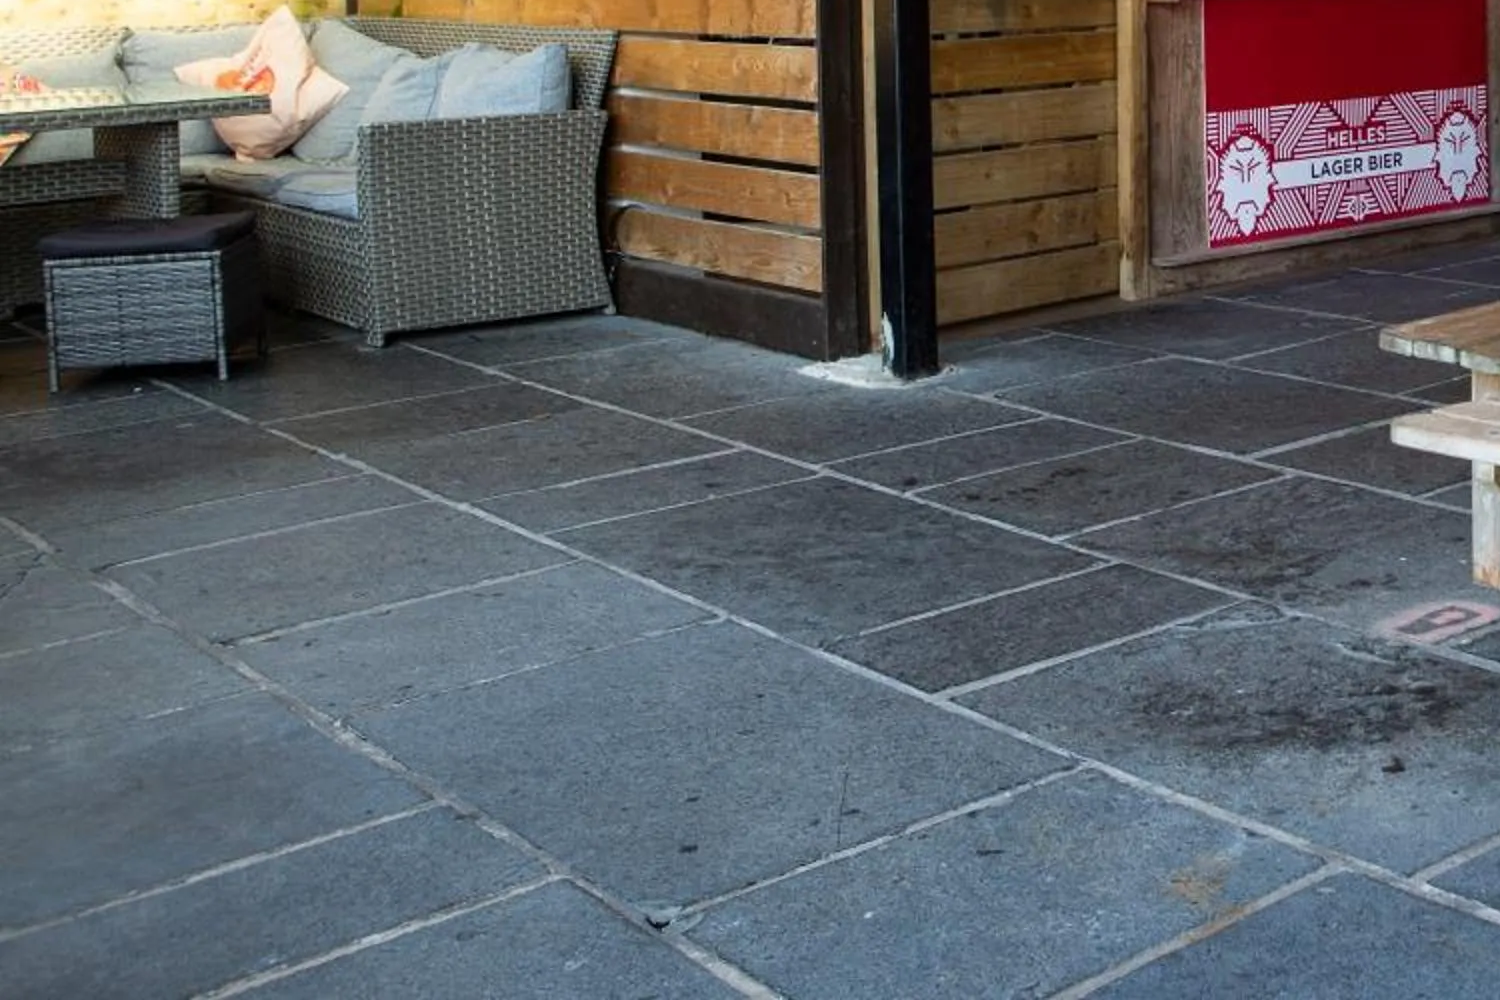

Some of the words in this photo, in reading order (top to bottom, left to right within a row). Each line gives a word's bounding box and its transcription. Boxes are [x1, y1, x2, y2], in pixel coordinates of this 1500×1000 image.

[1327, 126, 1386, 148] HELLES
[1311, 157, 1363, 179] LAGER
[1369, 152, 1403, 171] BIER
